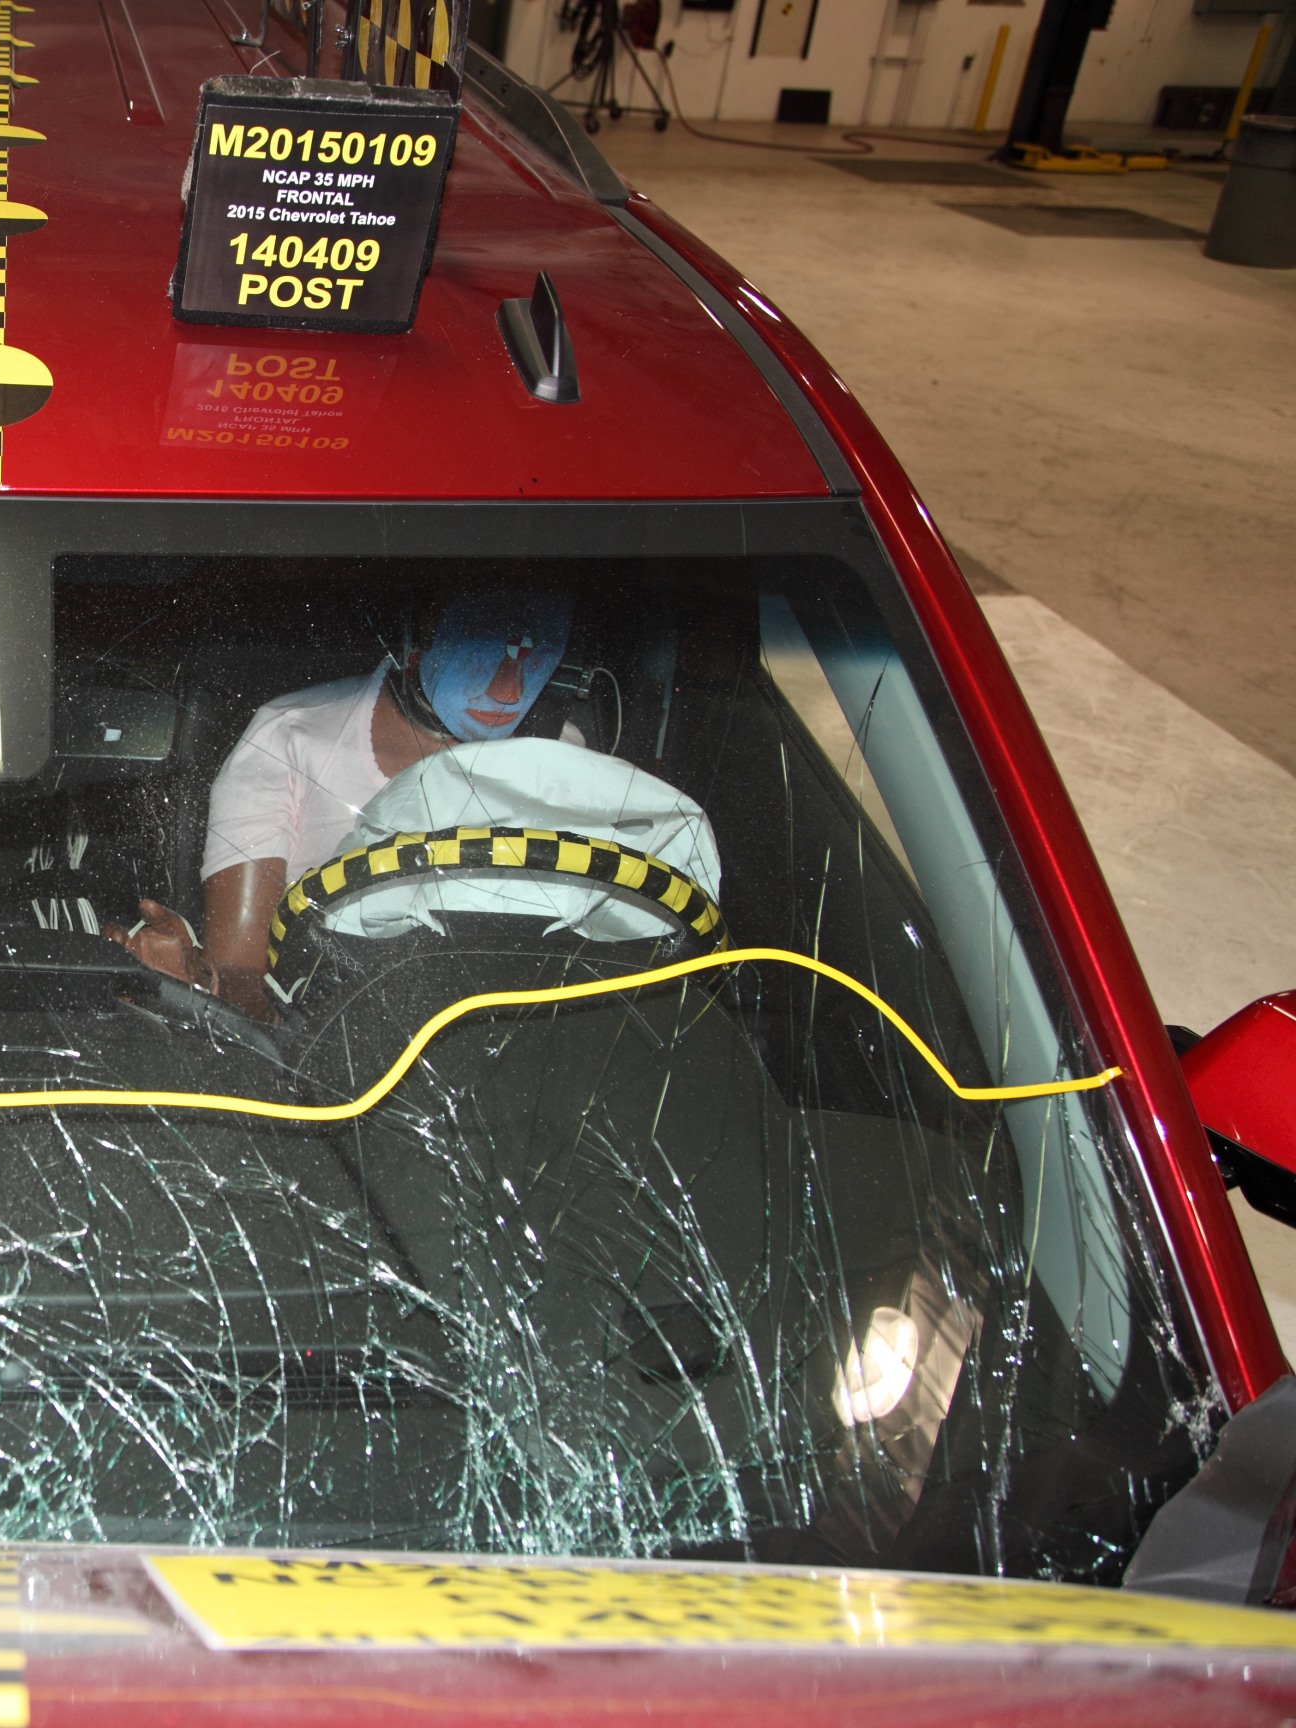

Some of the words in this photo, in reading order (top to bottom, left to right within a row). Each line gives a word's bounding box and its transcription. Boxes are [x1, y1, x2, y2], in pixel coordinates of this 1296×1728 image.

[208, 123, 438, 167] M20150109
[262, 169, 311, 186] NCAP
[313, 171, 334, 187] 35
[337, 173, 375, 188] MPH
[276, 189, 354, 206] FRONTAL
[227, 204, 265, 220] 2015
[269, 207, 345, 224] Chevrolet
[350, 211, 396, 227] Tahoe
[229, 232, 381, 272] 140409
[238, 274, 364, 310] POST
